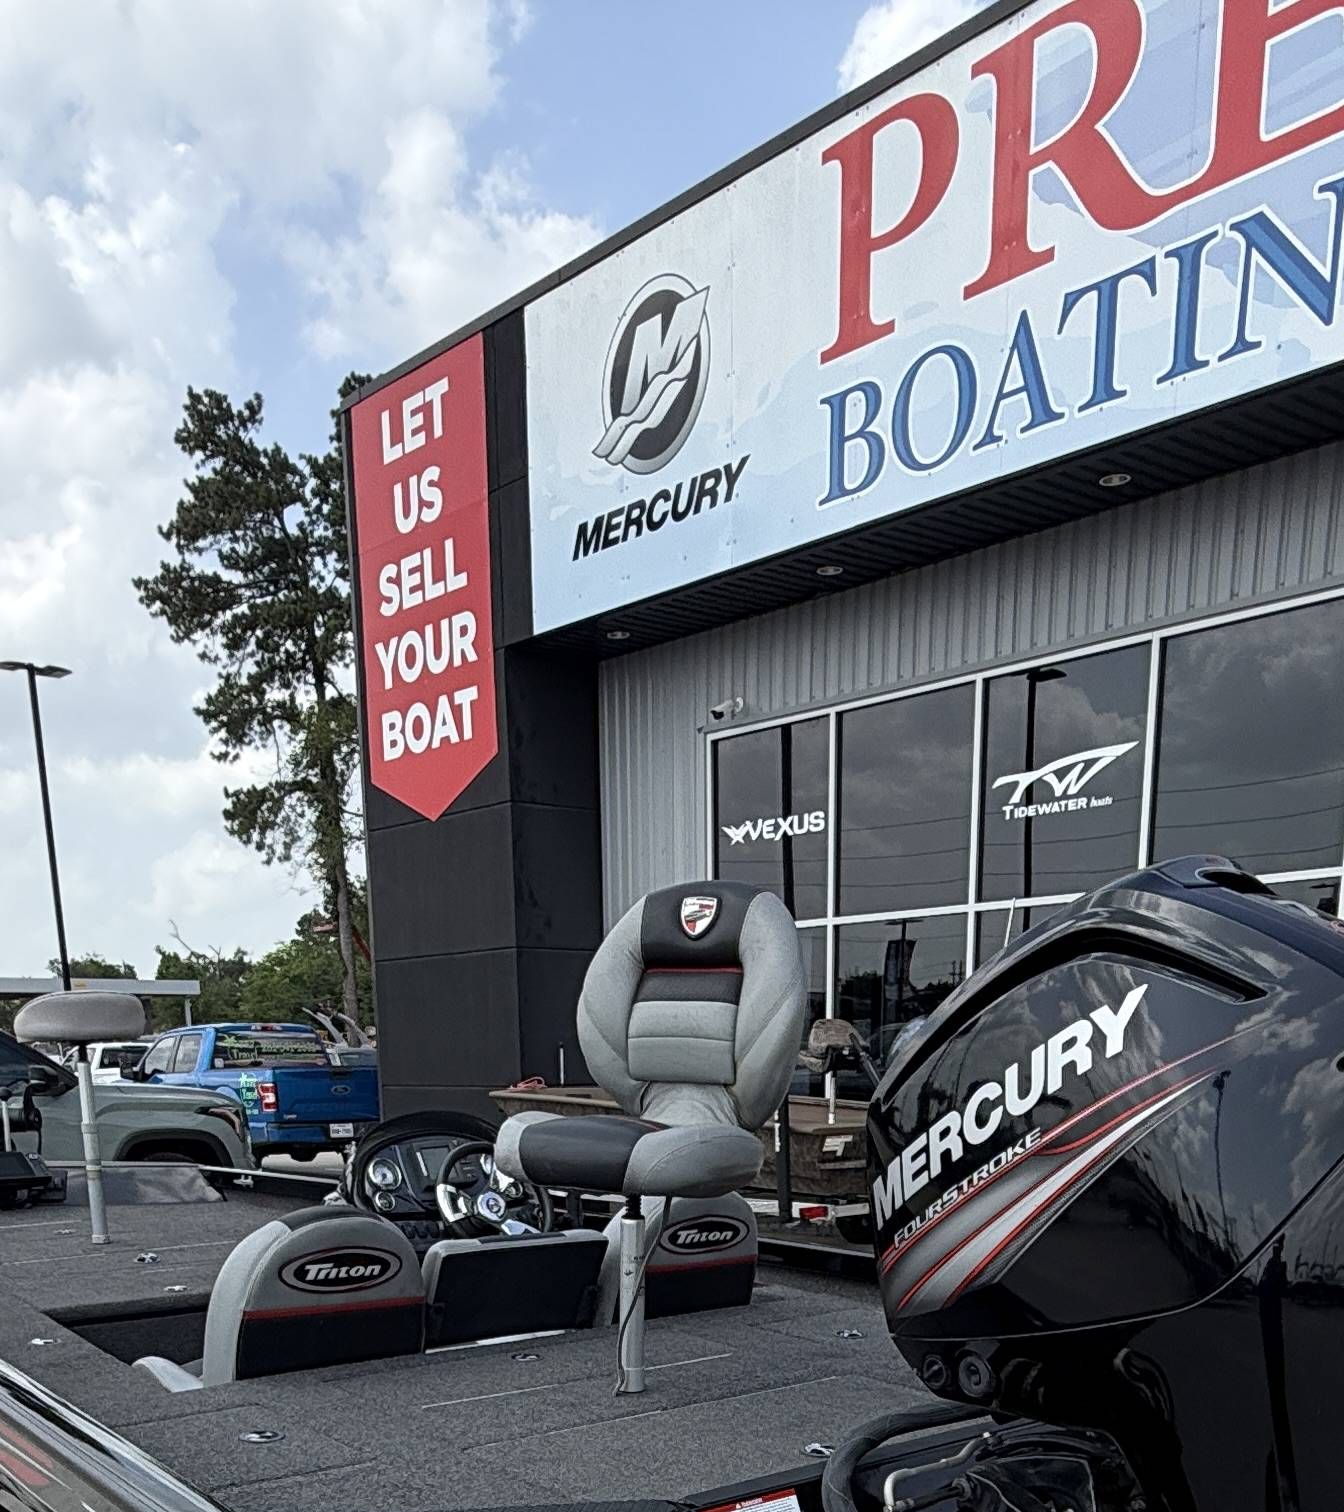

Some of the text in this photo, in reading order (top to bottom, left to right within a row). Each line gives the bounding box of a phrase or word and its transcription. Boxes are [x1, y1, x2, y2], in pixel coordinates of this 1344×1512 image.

[381, 376, 449, 465] LET
[394, 465, 443, 534] US
[572, 454, 751, 561] MERCURY
[379, 537, 468, 617] SELL
[375, 610, 478, 690] YOUR
[381, 685, 479, 762] BOAT
[746, 811, 825, 841] VEXUS
[1002, 797, 1087, 820] TIDEWATER
[873, 984, 1148, 1230] MERCURY
[894, 1127, 1041, 1249] FOURSTROKE
[304, 1263, 382, 1281] Triton
[676, 1229, 734, 1245] Triton
